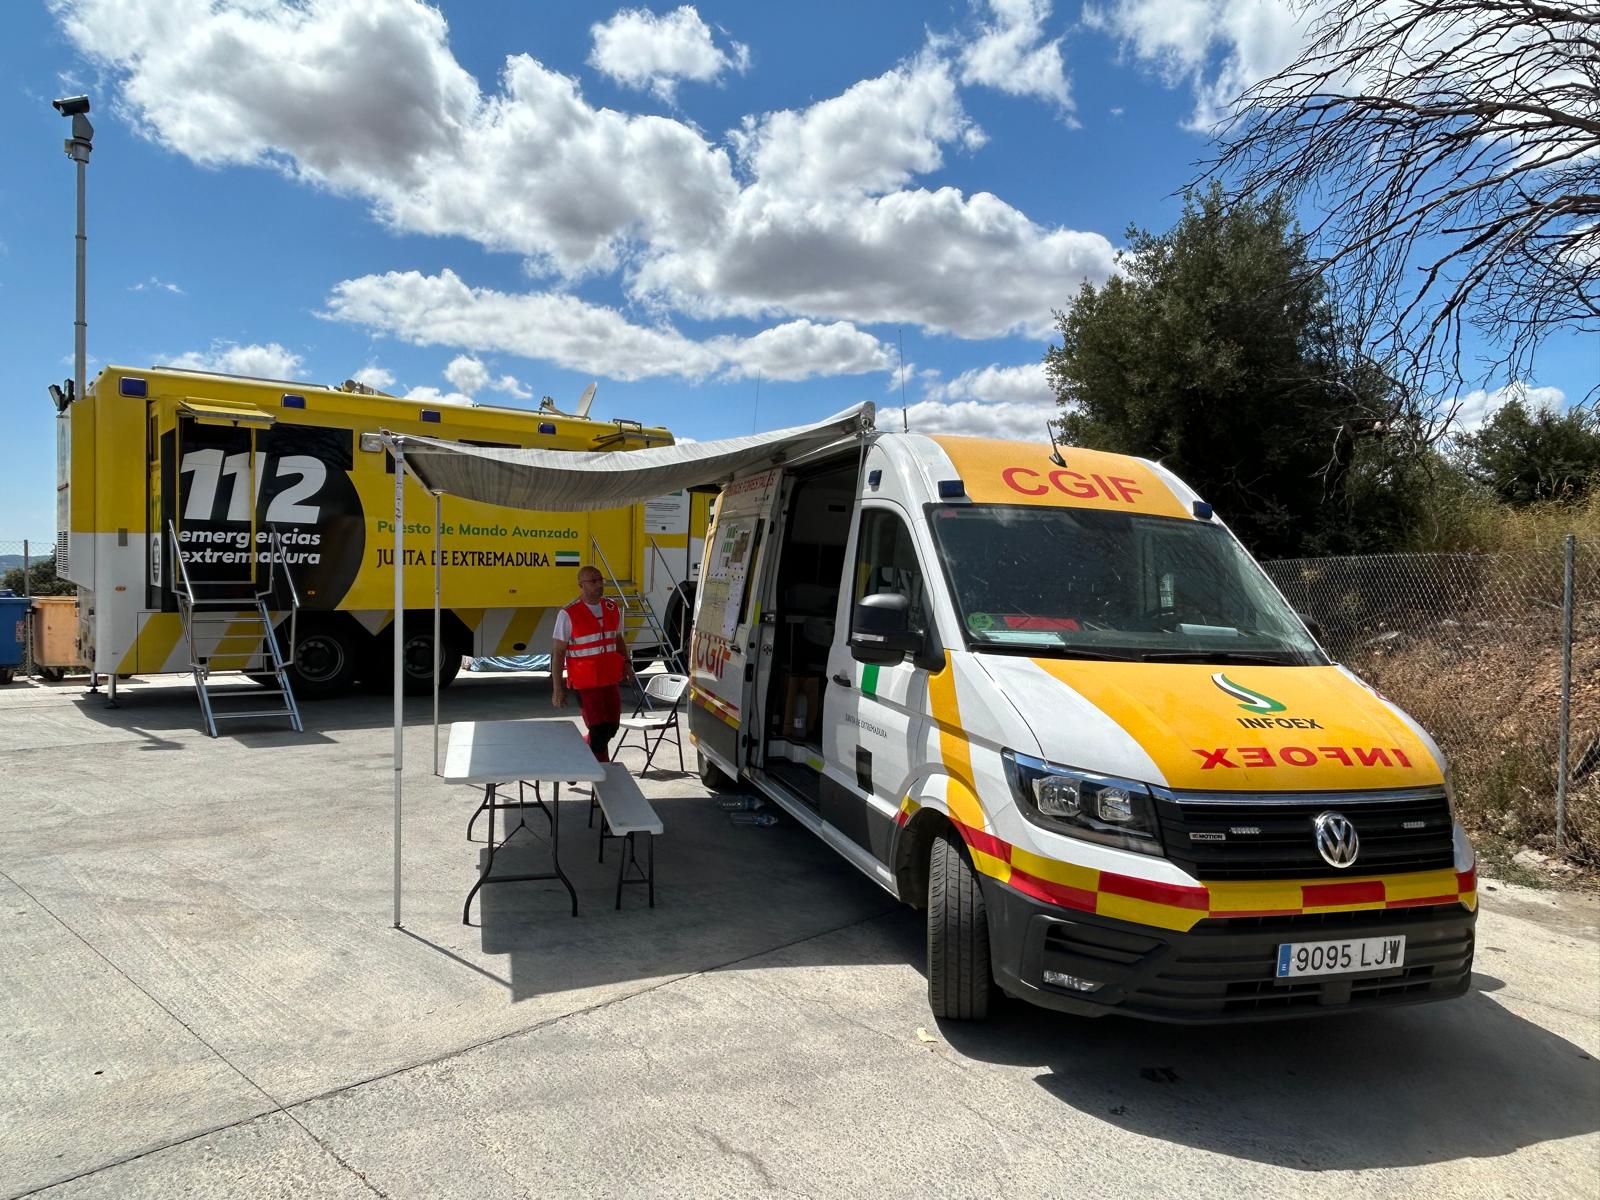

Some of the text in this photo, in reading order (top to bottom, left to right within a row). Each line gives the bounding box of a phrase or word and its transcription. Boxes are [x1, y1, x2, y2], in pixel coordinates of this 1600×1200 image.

[180, 448, 327, 524] 112
[1002, 467, 1144, 503] CGIF
[178, 528, 321, 548] emergencias
[459, 523, 508, 536] Mando
[511, 526, 578, 539] Avanzado
[180, 546, 321, 564] extremadura
[452, 550, 550, 567] EXTREMADURA
[1236, 717, 1325, 730] INFOEX
[1296, 944, 1352, 971] 9095
[1360, 939, 1401, 967] LJW
